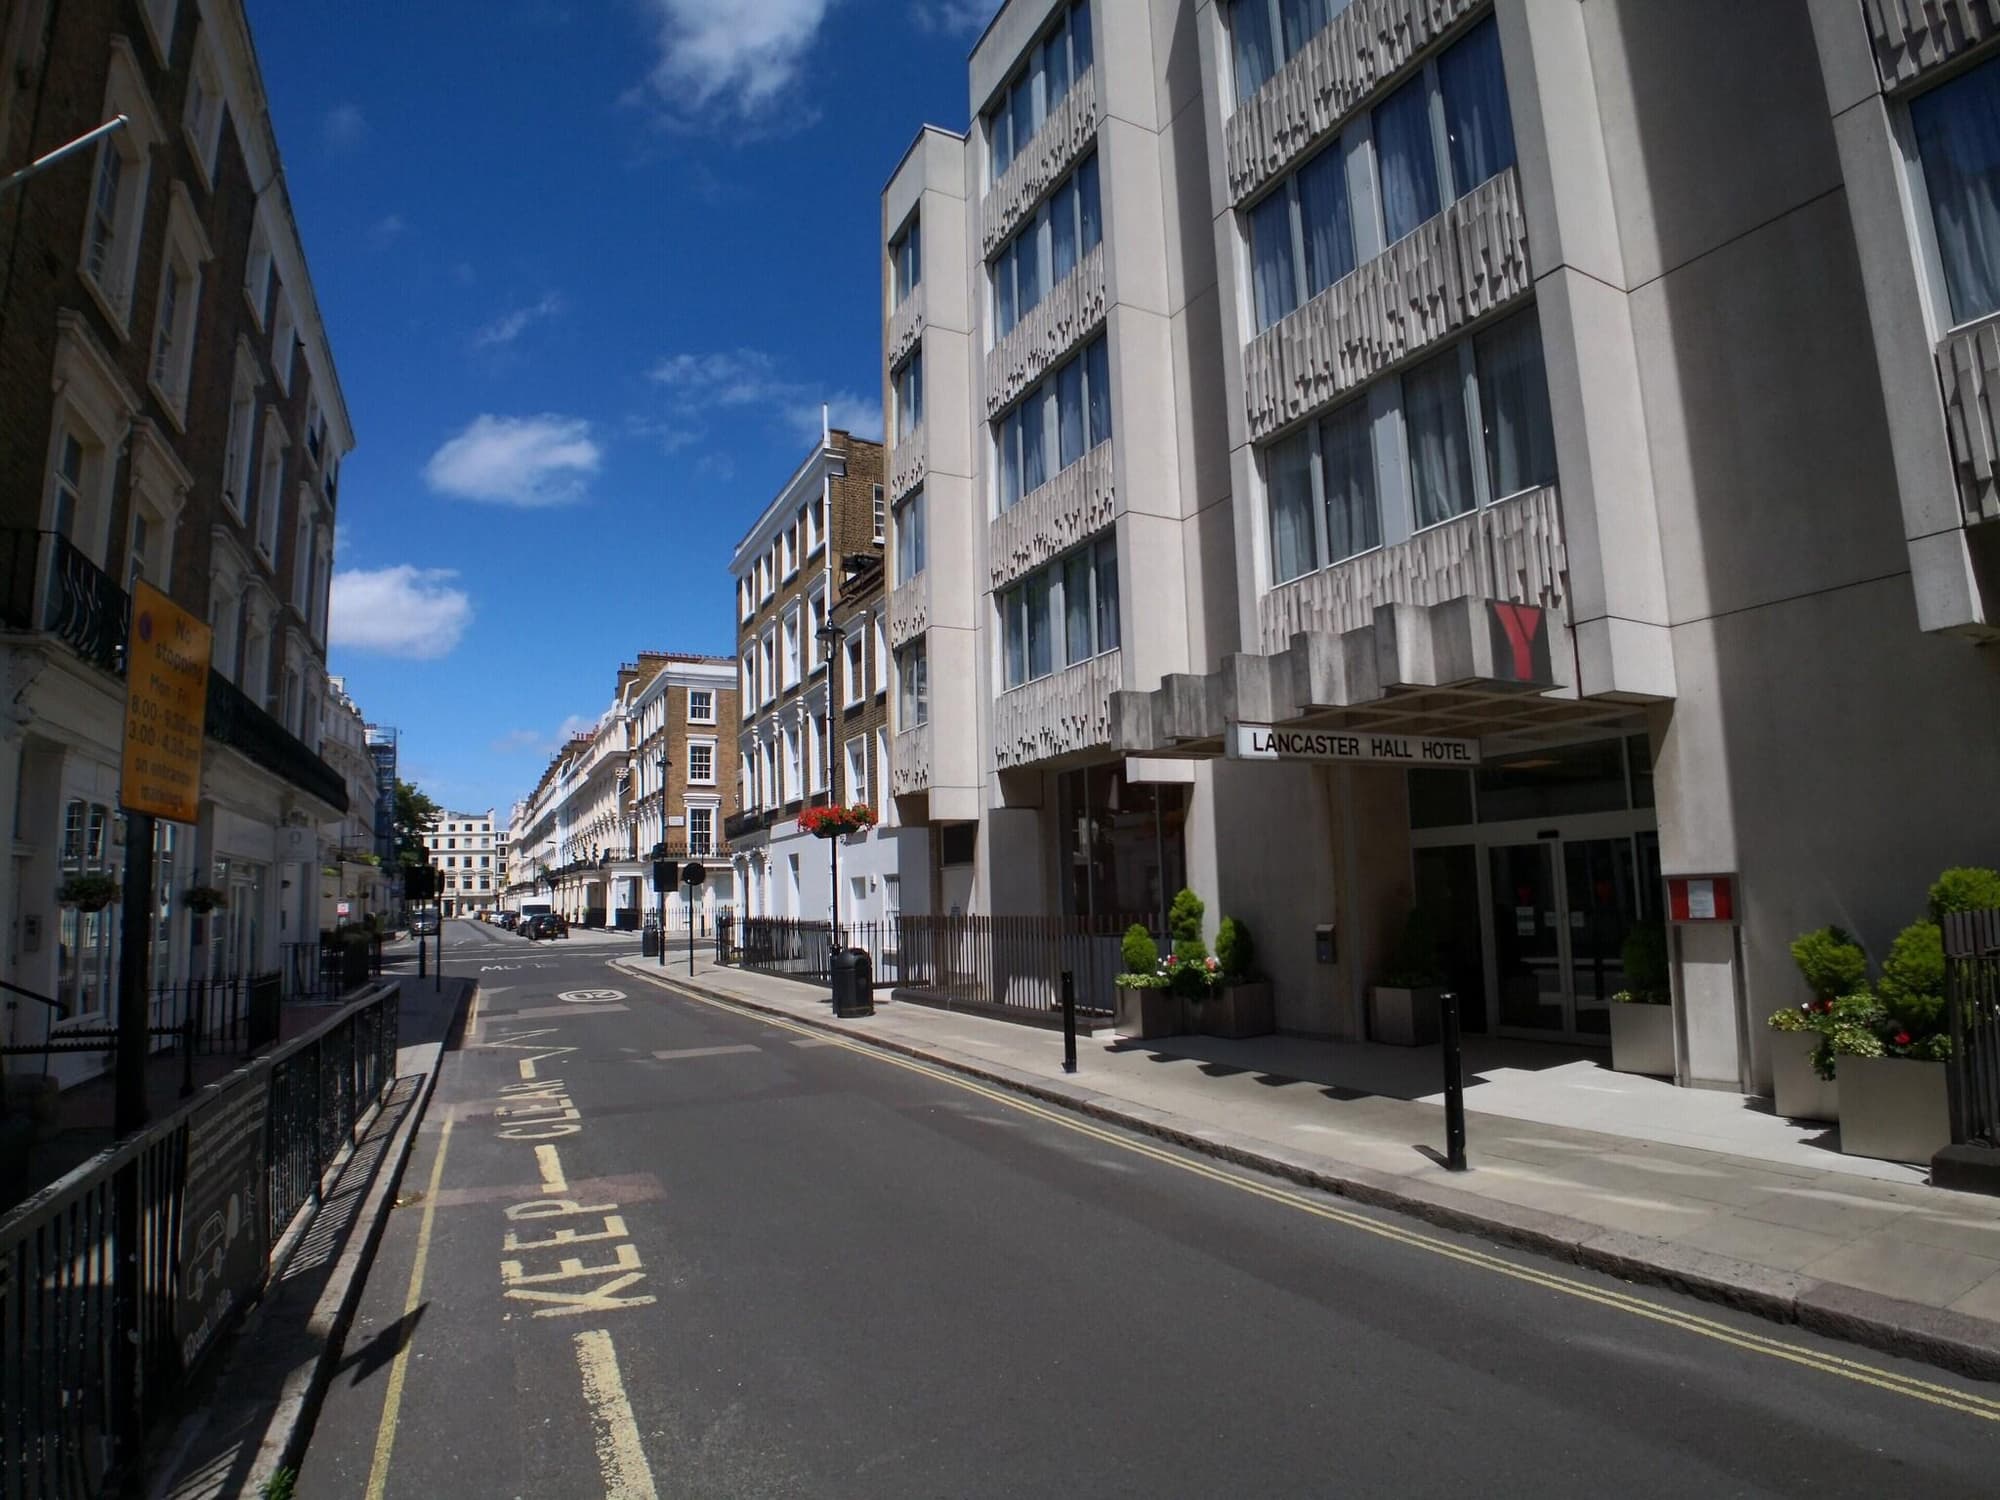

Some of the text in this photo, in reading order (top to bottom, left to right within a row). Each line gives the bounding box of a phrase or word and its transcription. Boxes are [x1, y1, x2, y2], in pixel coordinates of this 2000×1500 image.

[175, 617, 192, 645] No
[154, 641, 204, 688] stopping
[130, 694, 158, 721] 8.00
[128, 719, 156, 746] 3.00
[1253, 731, 1471, 761] LANCASTER HALL HOTEL
[495, 1079, 582, 1140] CLEAR
[501, 1200, 658, 1320] KEEP
